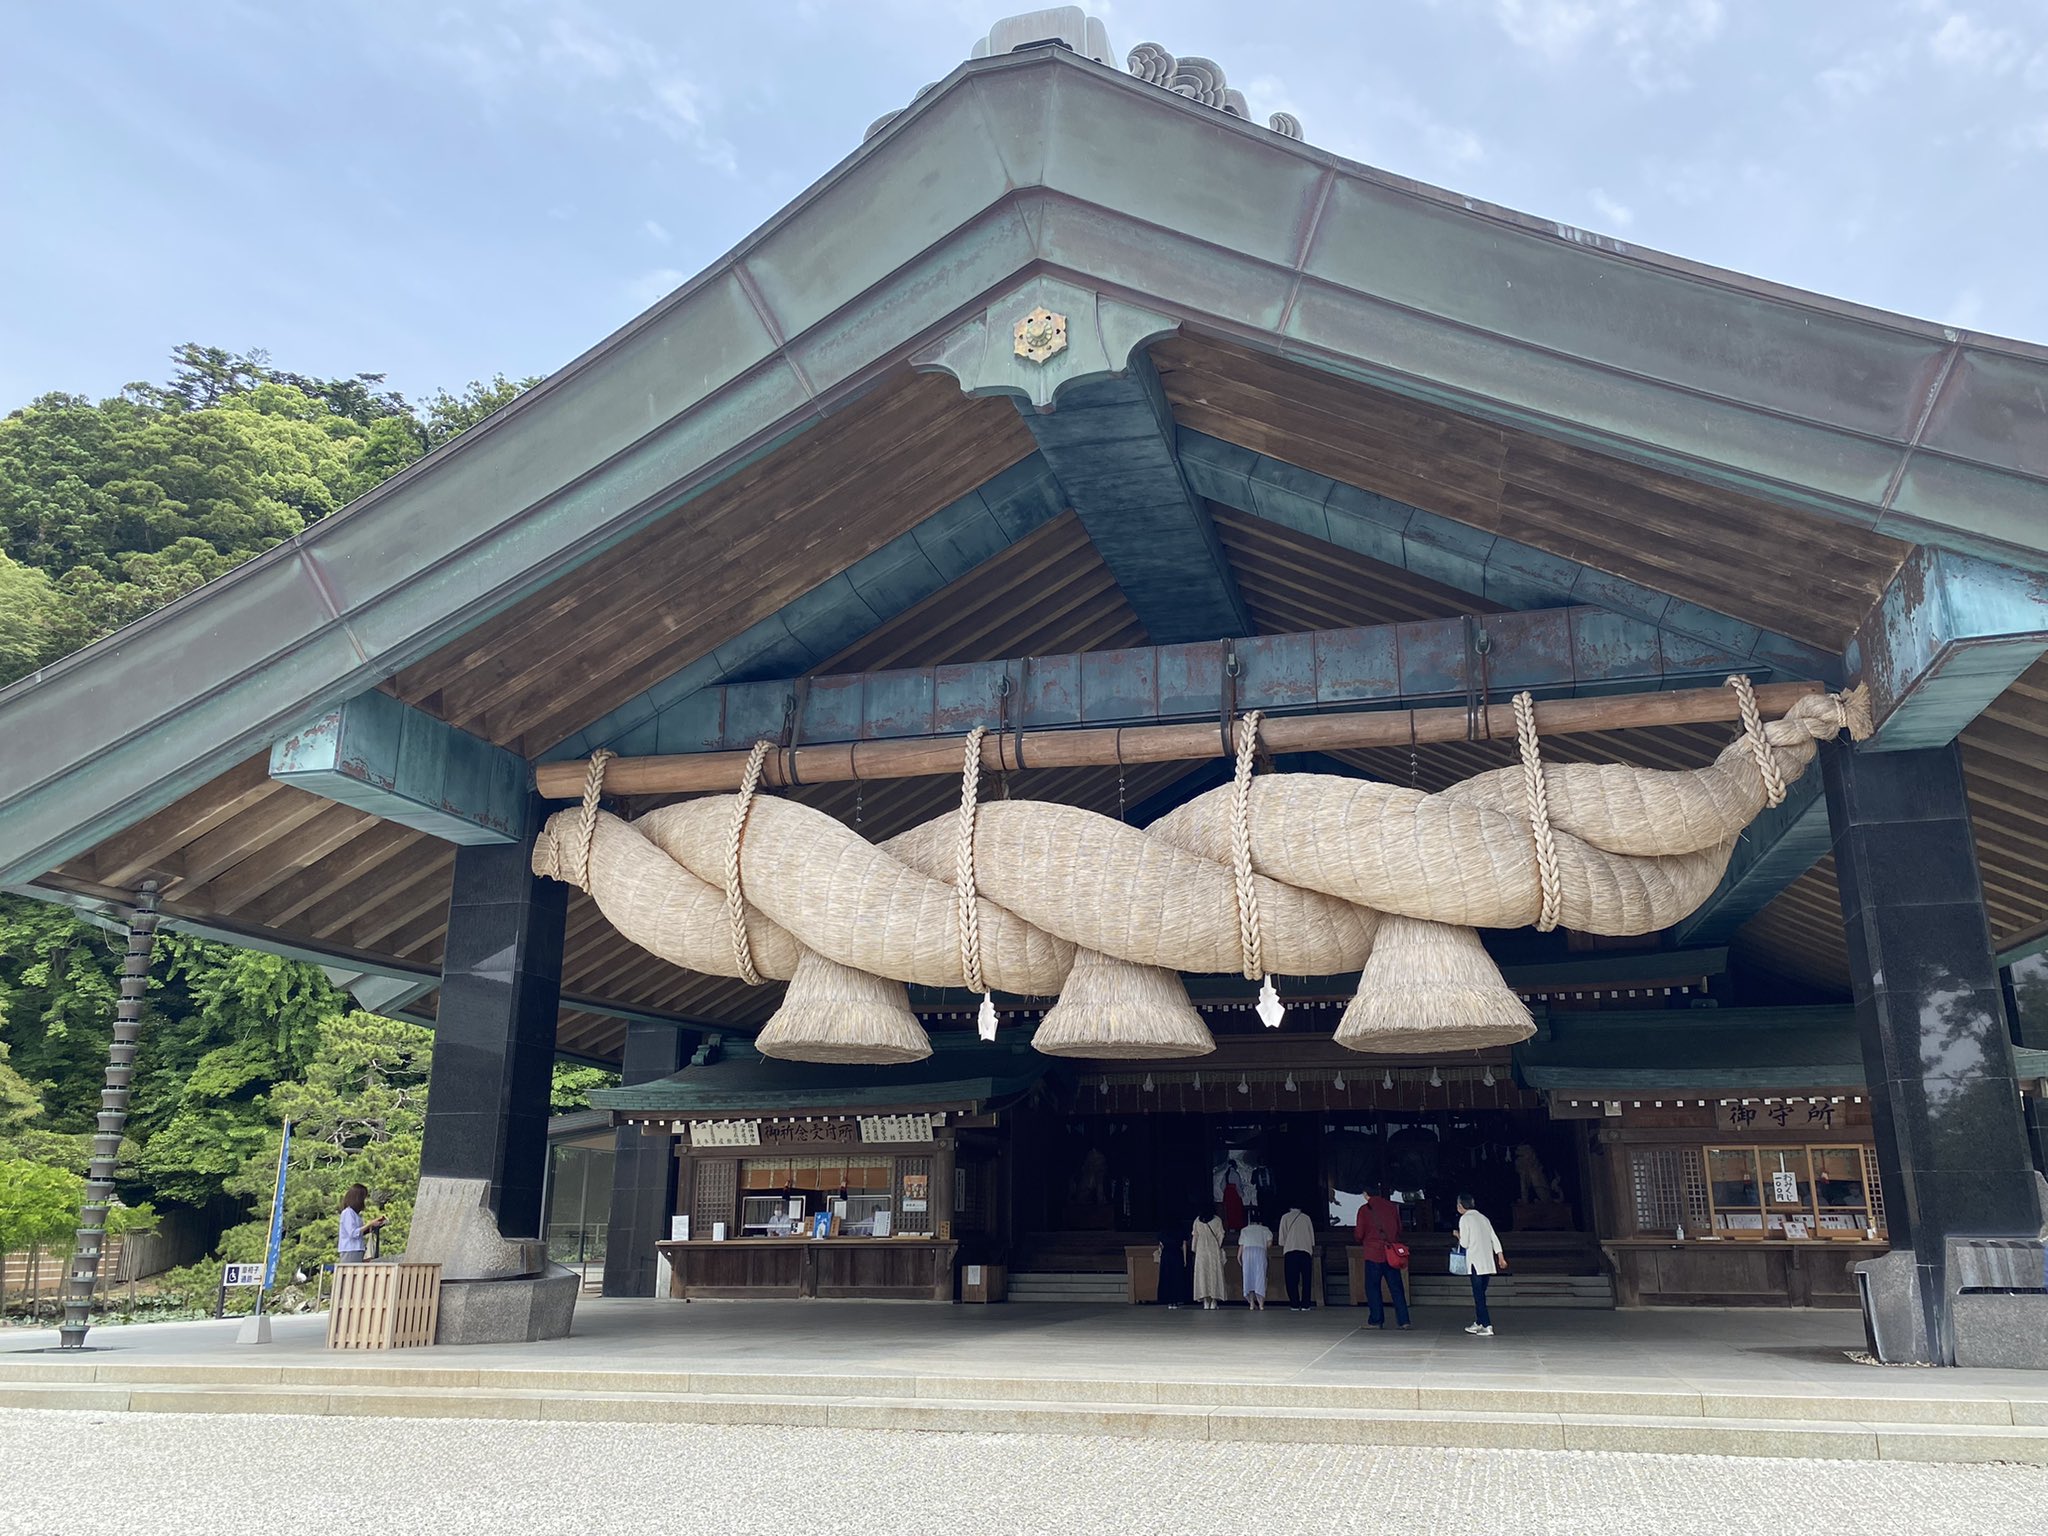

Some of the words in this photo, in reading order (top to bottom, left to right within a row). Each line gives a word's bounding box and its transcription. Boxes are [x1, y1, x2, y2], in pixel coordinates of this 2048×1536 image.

[1730, 1104, 1835, 1127] 御守所
[1783, 1174, 1793, 1201] おみくじ
